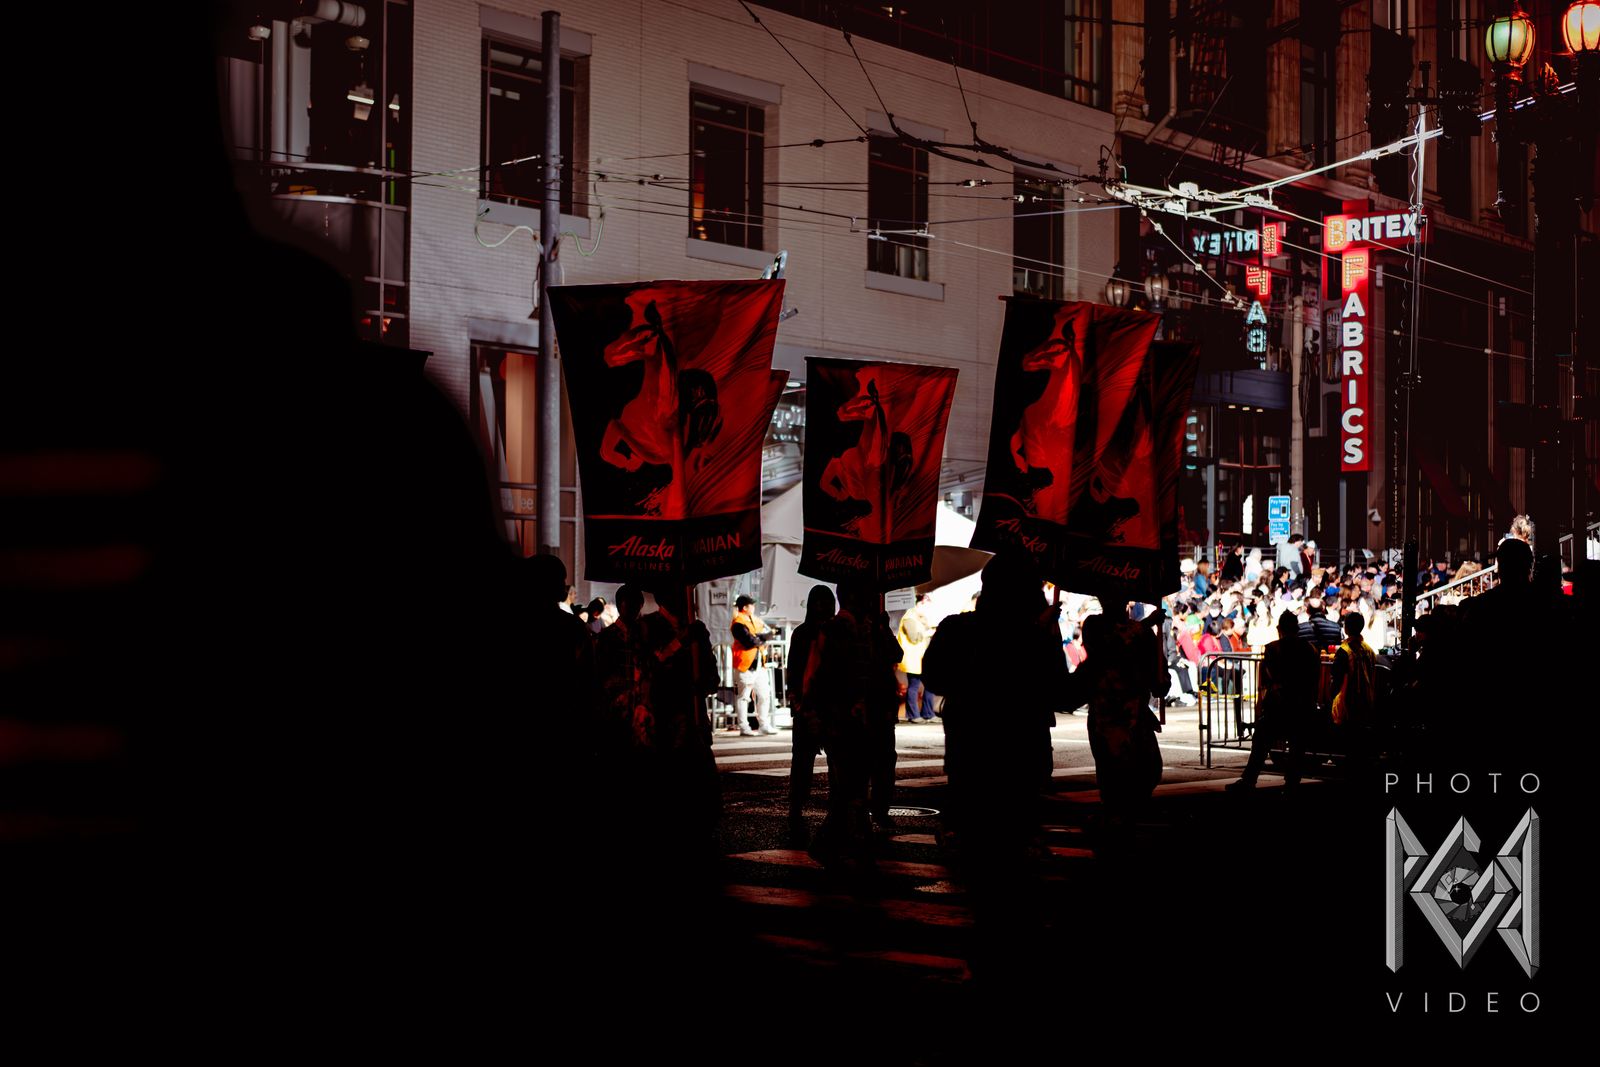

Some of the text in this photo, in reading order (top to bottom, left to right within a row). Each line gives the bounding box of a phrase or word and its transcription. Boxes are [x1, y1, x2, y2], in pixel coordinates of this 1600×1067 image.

[1327, 213, 1418, 248] BRITEX
[1341, 256, 1366, 465] FABRICS
[608, 534, 675, 560] Alaska
[815, 548, 871, 570] Alaska
[1077, 555, 1141, 580] Alaska
